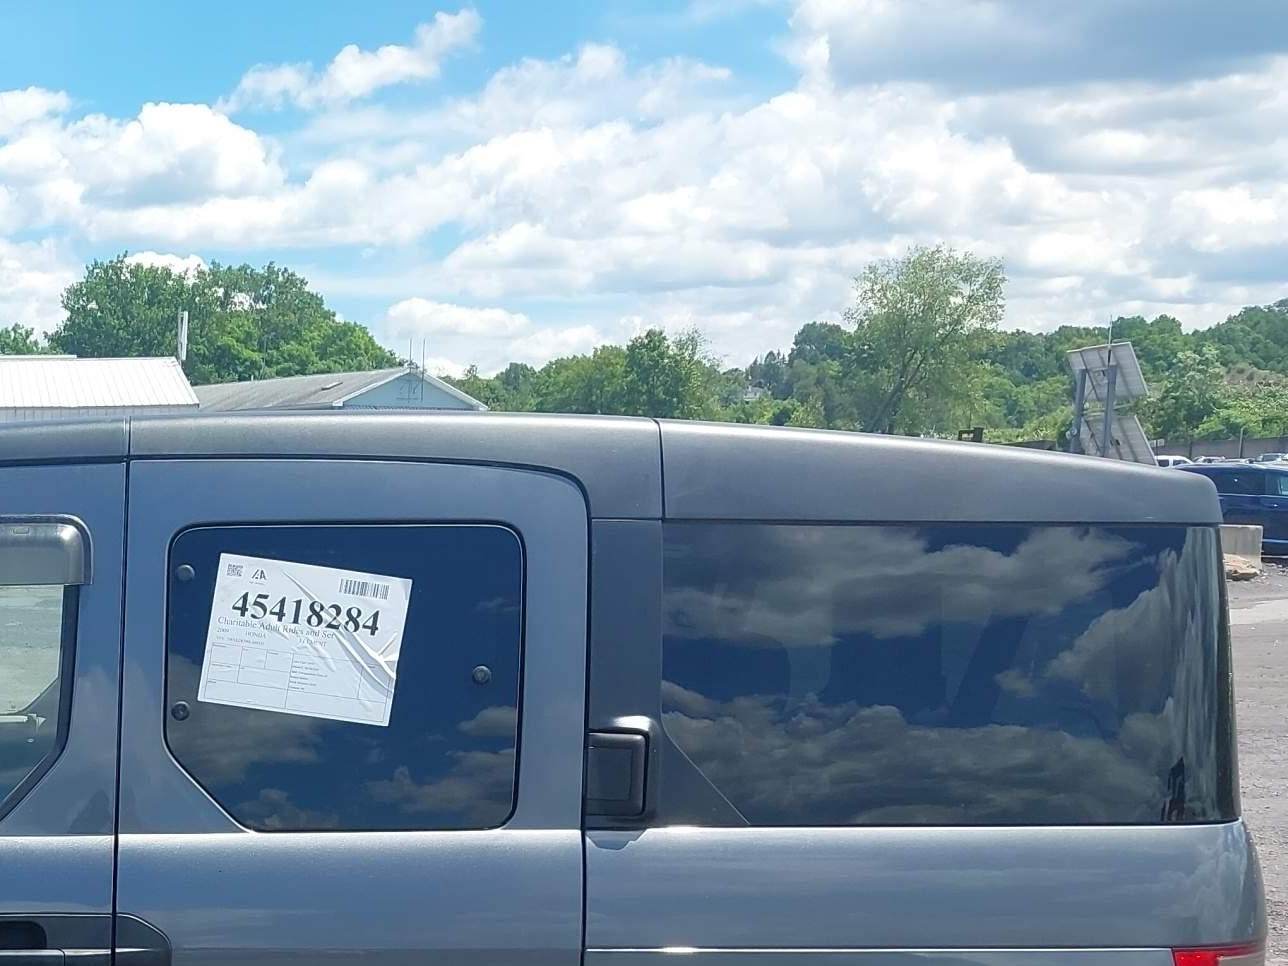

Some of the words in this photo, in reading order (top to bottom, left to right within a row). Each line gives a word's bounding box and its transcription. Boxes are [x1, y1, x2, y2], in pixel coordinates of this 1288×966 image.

[218, 616, 258, 628] Charitable
[259, 621, 281, 632] Adult
[305, 629, 320, 637] and
[232, 591, 380, 636] 45418284
